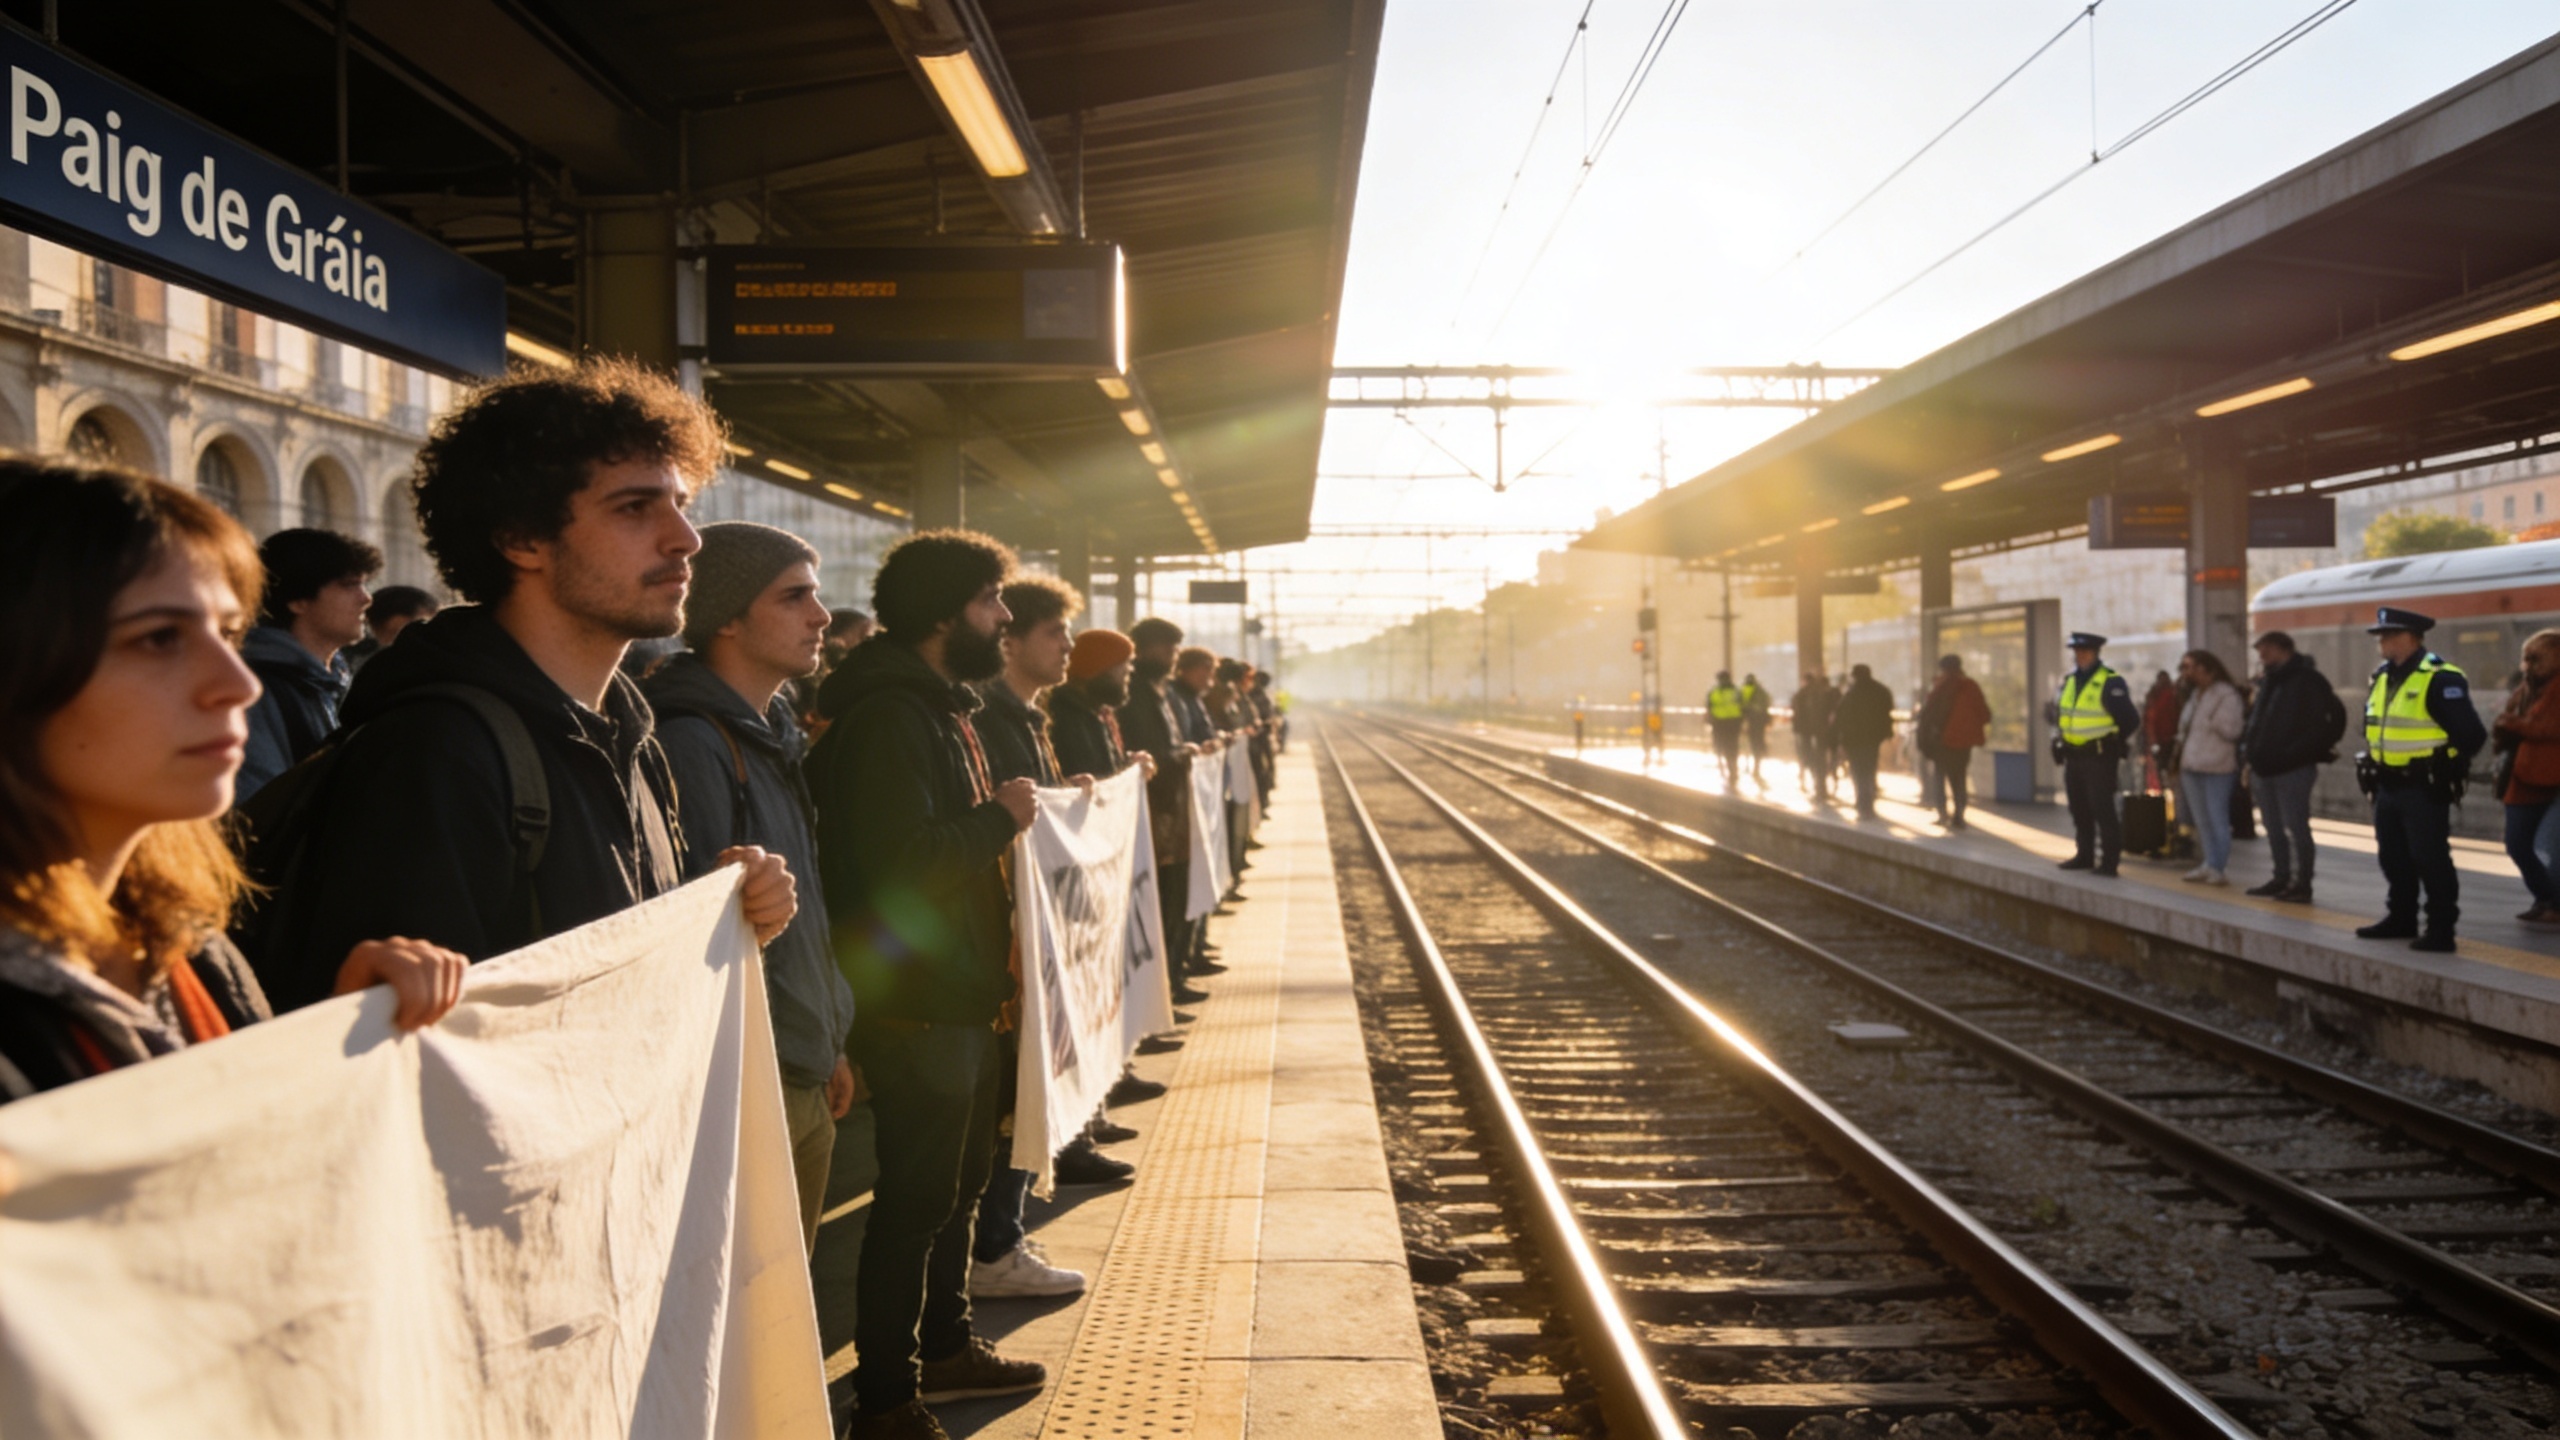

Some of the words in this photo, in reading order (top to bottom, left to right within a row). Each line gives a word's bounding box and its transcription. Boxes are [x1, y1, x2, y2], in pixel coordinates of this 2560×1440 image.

[11, 65, 162, 237] Paig
[181, 156, 250, 252] de
[266, 194, 389, 312] Gráia
